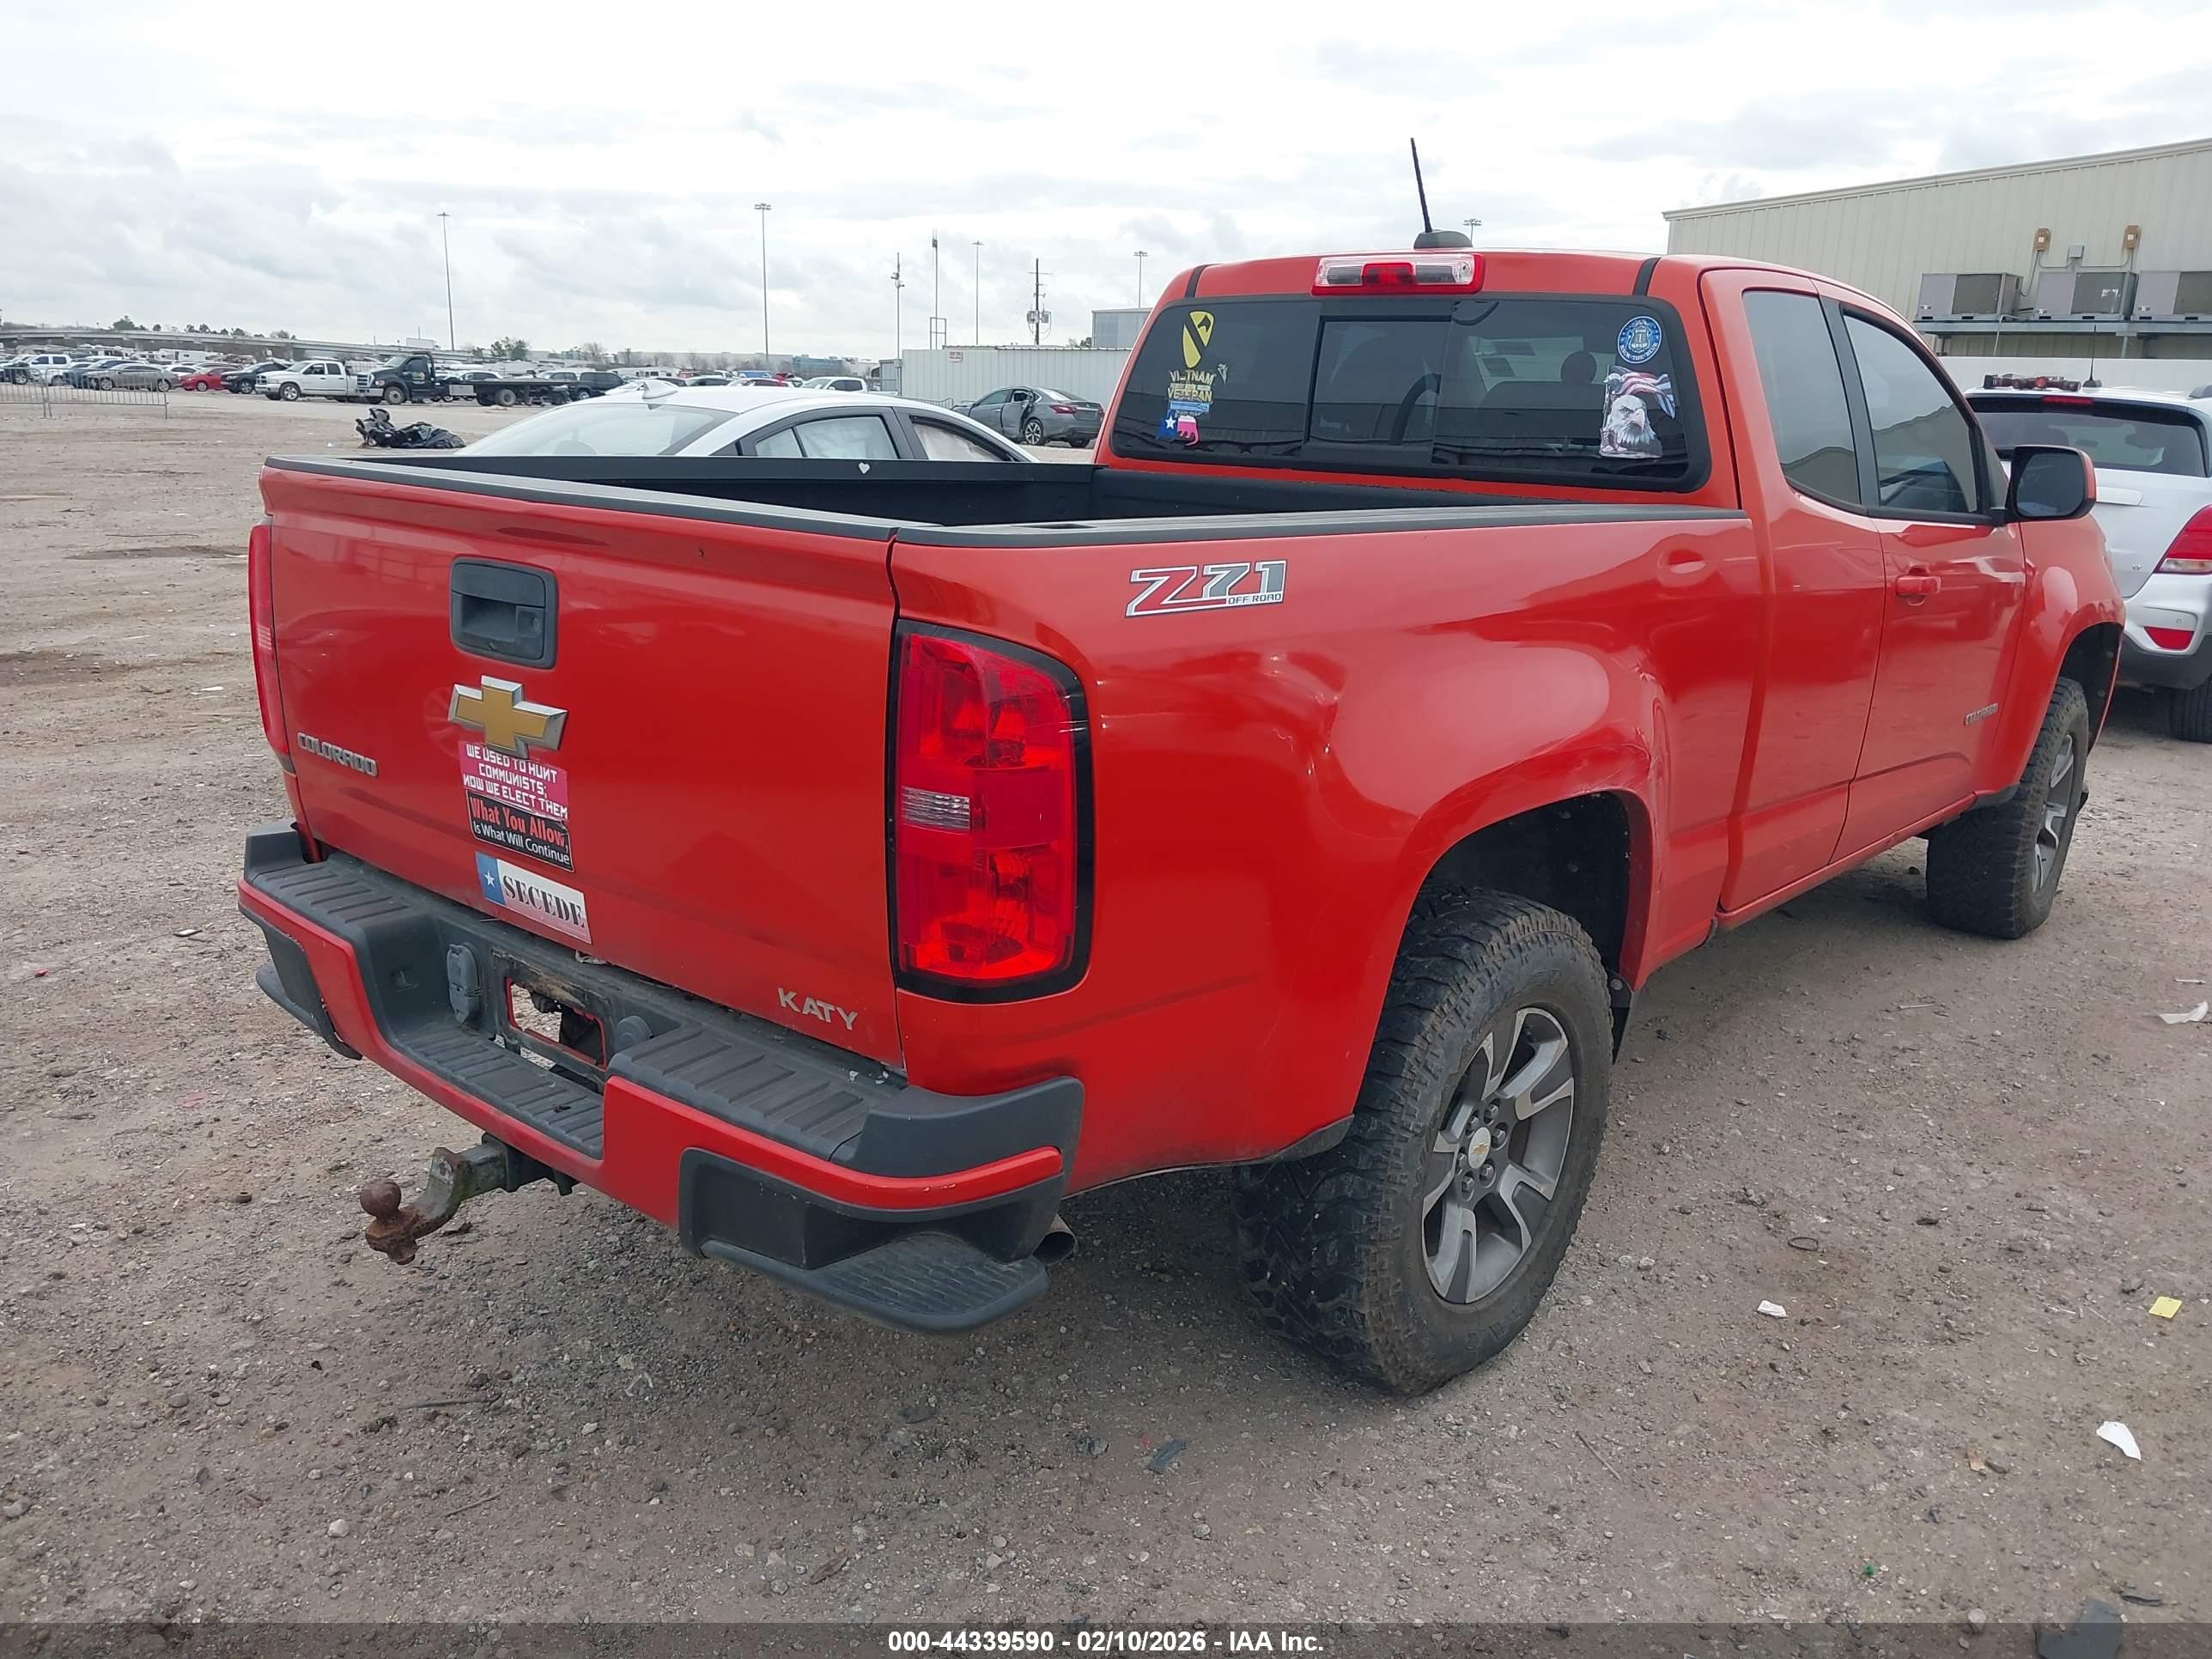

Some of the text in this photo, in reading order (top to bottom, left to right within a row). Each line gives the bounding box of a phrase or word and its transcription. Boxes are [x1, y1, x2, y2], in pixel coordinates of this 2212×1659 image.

[1125, 559, 1287, 617] Z71
[1228, 592, 1282, 605] OFF ROAD
[296, 732, 379, 777] COLORADO
[466, 744, 557, 783] WE USED TO HUNT
[463, 774, 568, 819] NOW WE ELECT THEM
[478, 763, 548, 799] COMMUNISTS;
[470, 797, 569, 853] What You Allow,
[473, 820, 570, 865] Is What Will Continue
[502, 874, 585, 928] SECEDE
[777, 988, 858, 1030] KATY
